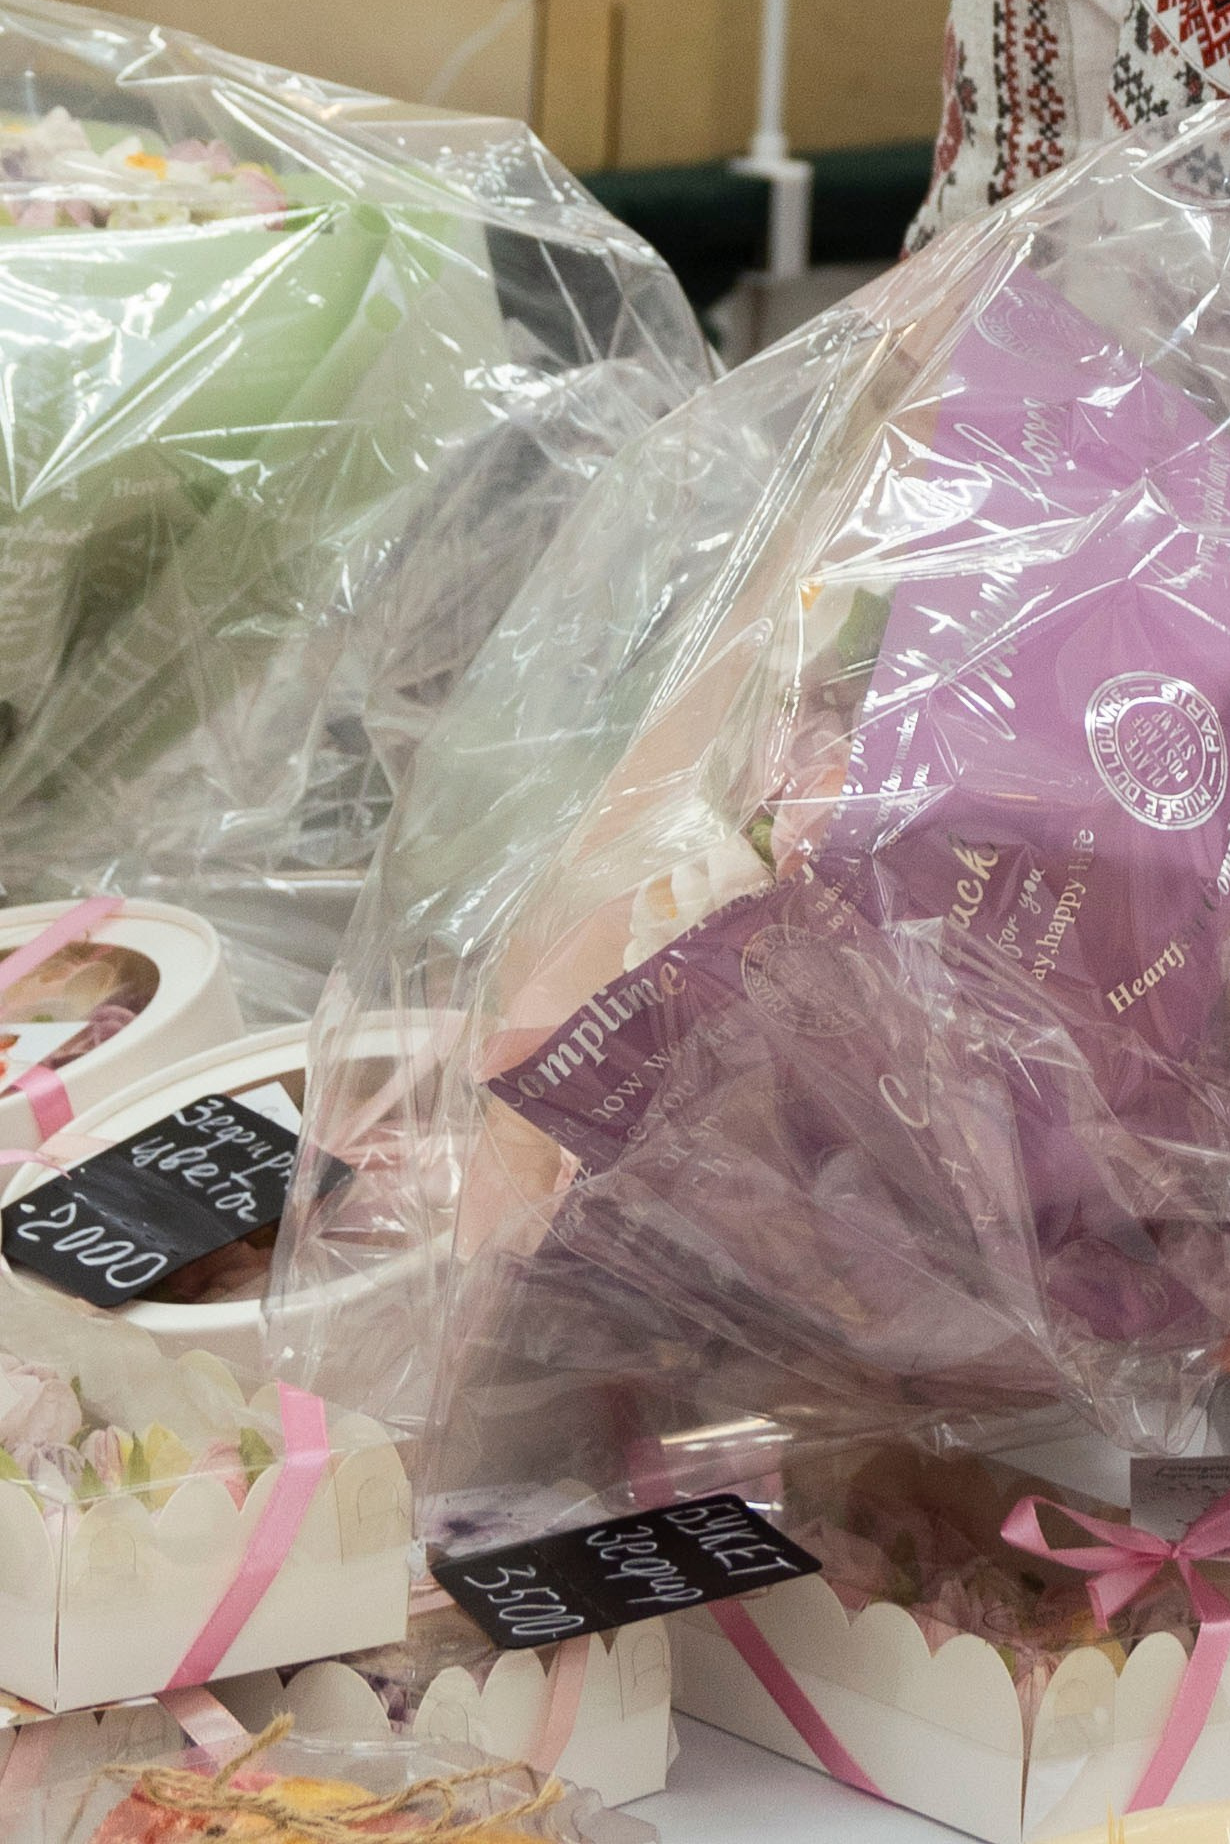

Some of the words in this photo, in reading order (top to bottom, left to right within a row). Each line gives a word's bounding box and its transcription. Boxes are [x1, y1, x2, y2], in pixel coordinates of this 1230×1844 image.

[1095, 687, 1131, 769] LOUVRE
[1160, 683, 1221, 753] PARIS
[1124, 735, 1169, 789] PLACE
[1131, 716, 1189, 783] POSTAGE
[1151, 709, 1197, 761] STAMP
[947, 834, 999, 932] uck
[985, 913, 1022, 960] for
[1018, 868, 1046, 915] you
[1031, 877, 1086, 981] ay,happy
[488, 950, 688, 1110] Complime
[665, 1502, 801, 1577] БУКЕТ
